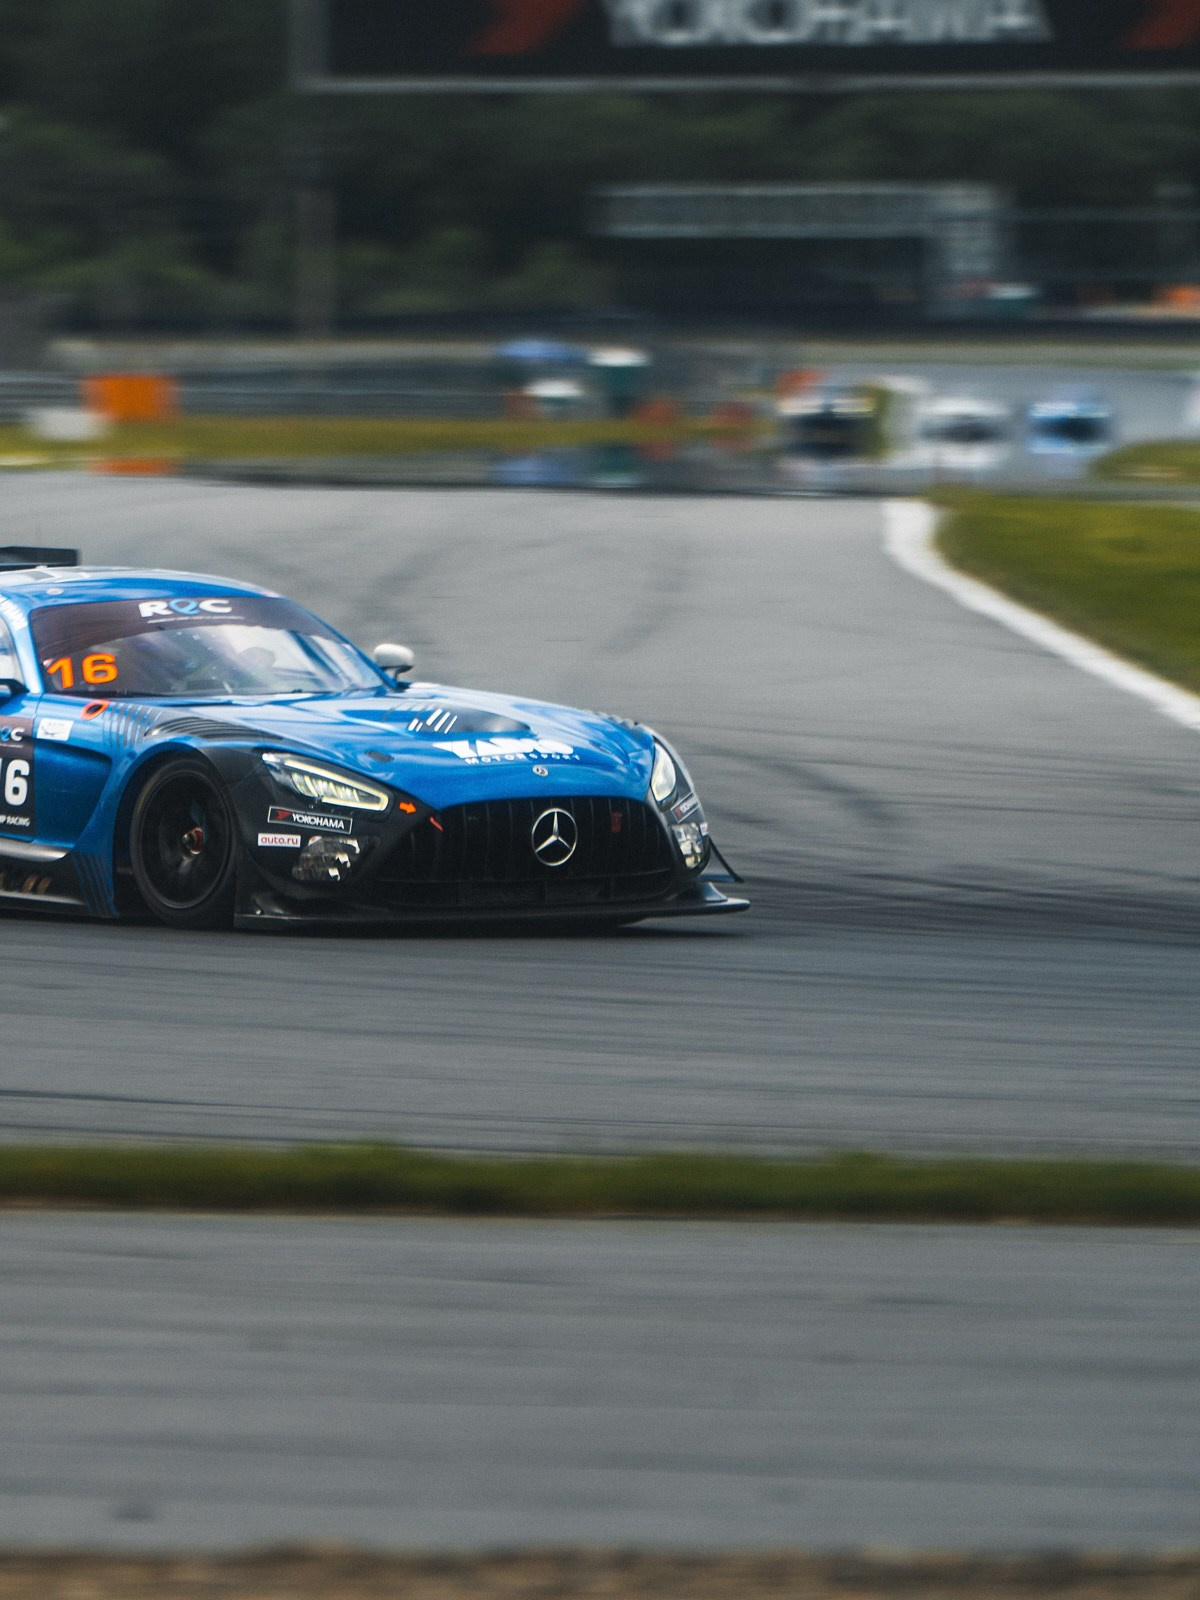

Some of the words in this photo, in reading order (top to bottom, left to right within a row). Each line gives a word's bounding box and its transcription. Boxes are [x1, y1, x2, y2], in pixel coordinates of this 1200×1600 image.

[46, 653, 118, 689] 16
[7, 815, 31, 827] RACING
[291, 813, 345, 830] YOKOHAMA
[260, 836, 299, 846] auto.ru
